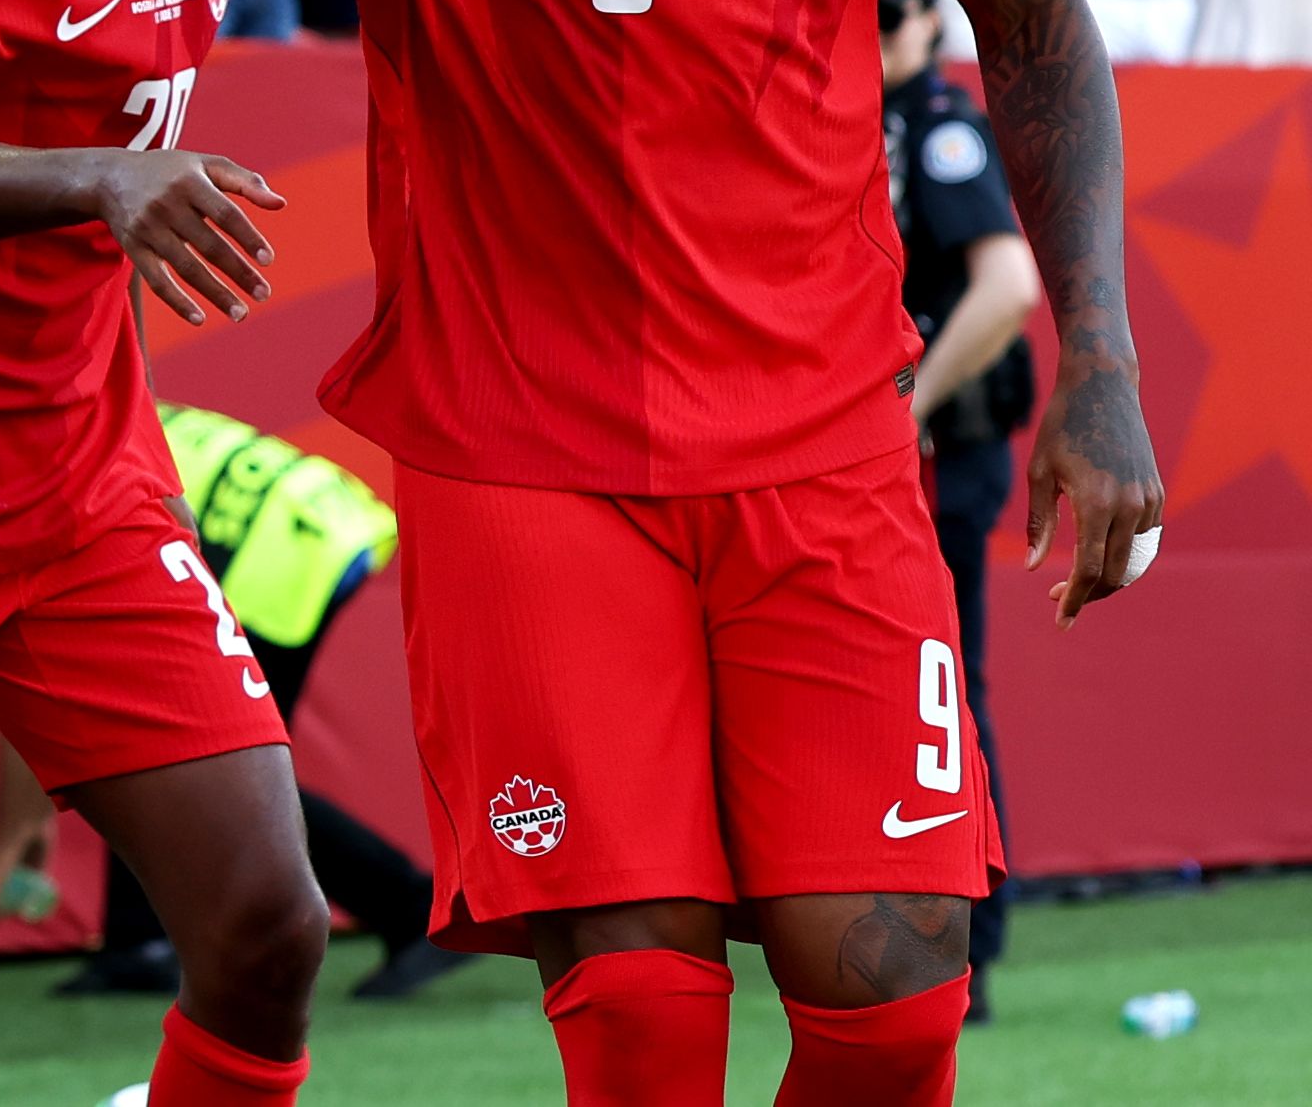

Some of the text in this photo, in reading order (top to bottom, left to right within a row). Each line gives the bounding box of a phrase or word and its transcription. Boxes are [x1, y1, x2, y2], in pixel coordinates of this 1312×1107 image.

[122, 67, 196, 152] 20
[916, 638, 961, 794] 9
[492, 807, 563, 830] CANADA
